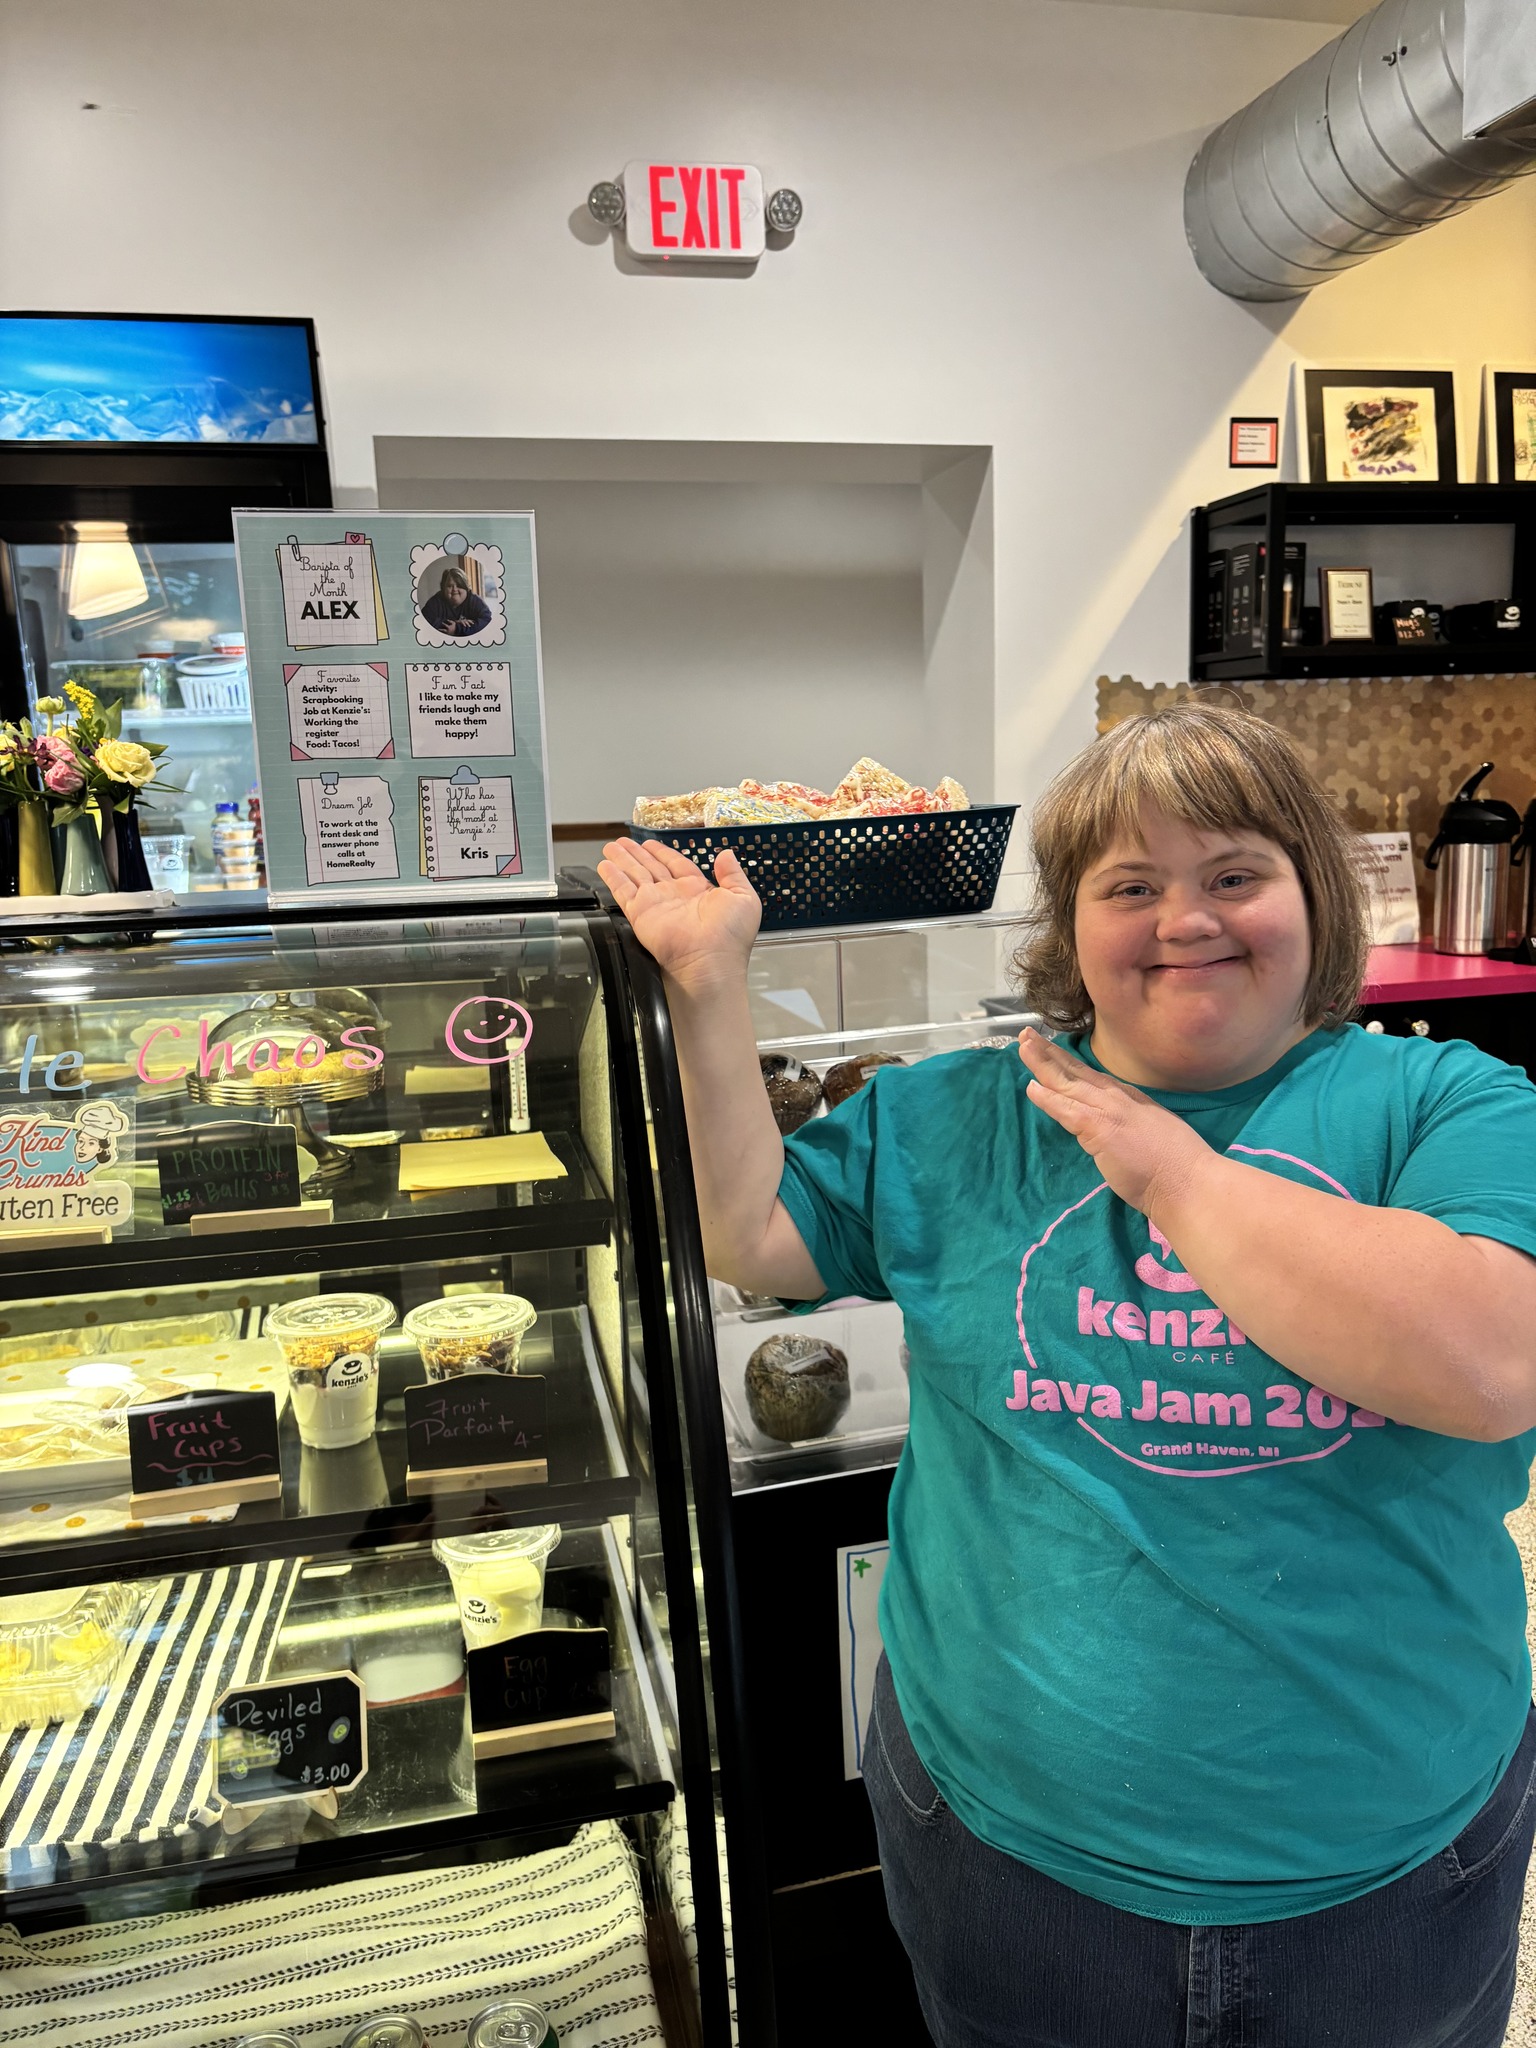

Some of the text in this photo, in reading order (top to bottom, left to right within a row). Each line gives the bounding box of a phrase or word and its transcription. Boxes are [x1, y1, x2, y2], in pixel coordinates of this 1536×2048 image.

[649, 166, 745, 249] EXIT
[300, 556, 354, 579] Barista of
[320, 573, 335, 584] the
[310, 582, 347, 597] Month
[301, 601, 360, 620] ALEX
[317, 669, 361, 683] Favorites
[432, 675, 486, 690] Fun Fact
[302, 685, 338, 694] Activity:
[419, 691, 499, 702] I like to make my
[303, 695, 364, 705] Scrapbooking
[303, 707, 319, 715] Job
[332, 706, 371, 714] Kenzie's:
[419, 703, 501, 715] friends laugh and
[304, 717, 359, 728] Working the
[435, 716, 487, 726] make them
[305, 729, 340, 739] register
[445, 728, 478, 740] happy!
[306, 739, 360, 748] Food: Tacos!
[446, 786, 495, 801] Who has
[321, 796, 373, 816] Dream Job
[446, 798, 497, 820] helped you
[319, 820, 330, 828] To
[331, 820, 353, 828] work
[365, 819, 378, 827] the
[446, 810, 499, 824] the most at
[320, 829, 379, 838] front desk and
[449, 820, 497, 842] Kenzie's?
[354, 839, 380, 849] phone
[337, 850, 355, 858] calls
[461, 847, 489, 859] Kris
[326, 859, 375, 868] HomeRealty
[136, 1019, 385, 1084] Chaos
[0, 1118, 72, 1167] Kind
[172, 1141, 281, 1174] PROTEIN
[0, 1158, 89, 1190] Crumbs
[204, 1179, 258, 1203] Balls
[62, 1193, 119, 1217] Free
[1172, 1350, 1235, 1365] CAFÉ
[331, 1373, 369, 1388] kenzie's
[1005, 1370, 1123, 1419] Java
[1132, 1380, 1252, 1426] Jam
[425, 1398, 491, 1419] Fruit
[148, 1410, 231, 1440] Fruit
[409, 1414, 514, 1446] Parfait
[174, 1437, 242, 1458] Cups
[1140, 1442, 1280, 1457] Grand Haven, MI
[503, 1655, 548, 1684] Egg
[229, 1687, 322, 1727] Deviled
[252, 1723, 306, 1759] Eggs
[300, 1762, 350, 1785] $3.00
